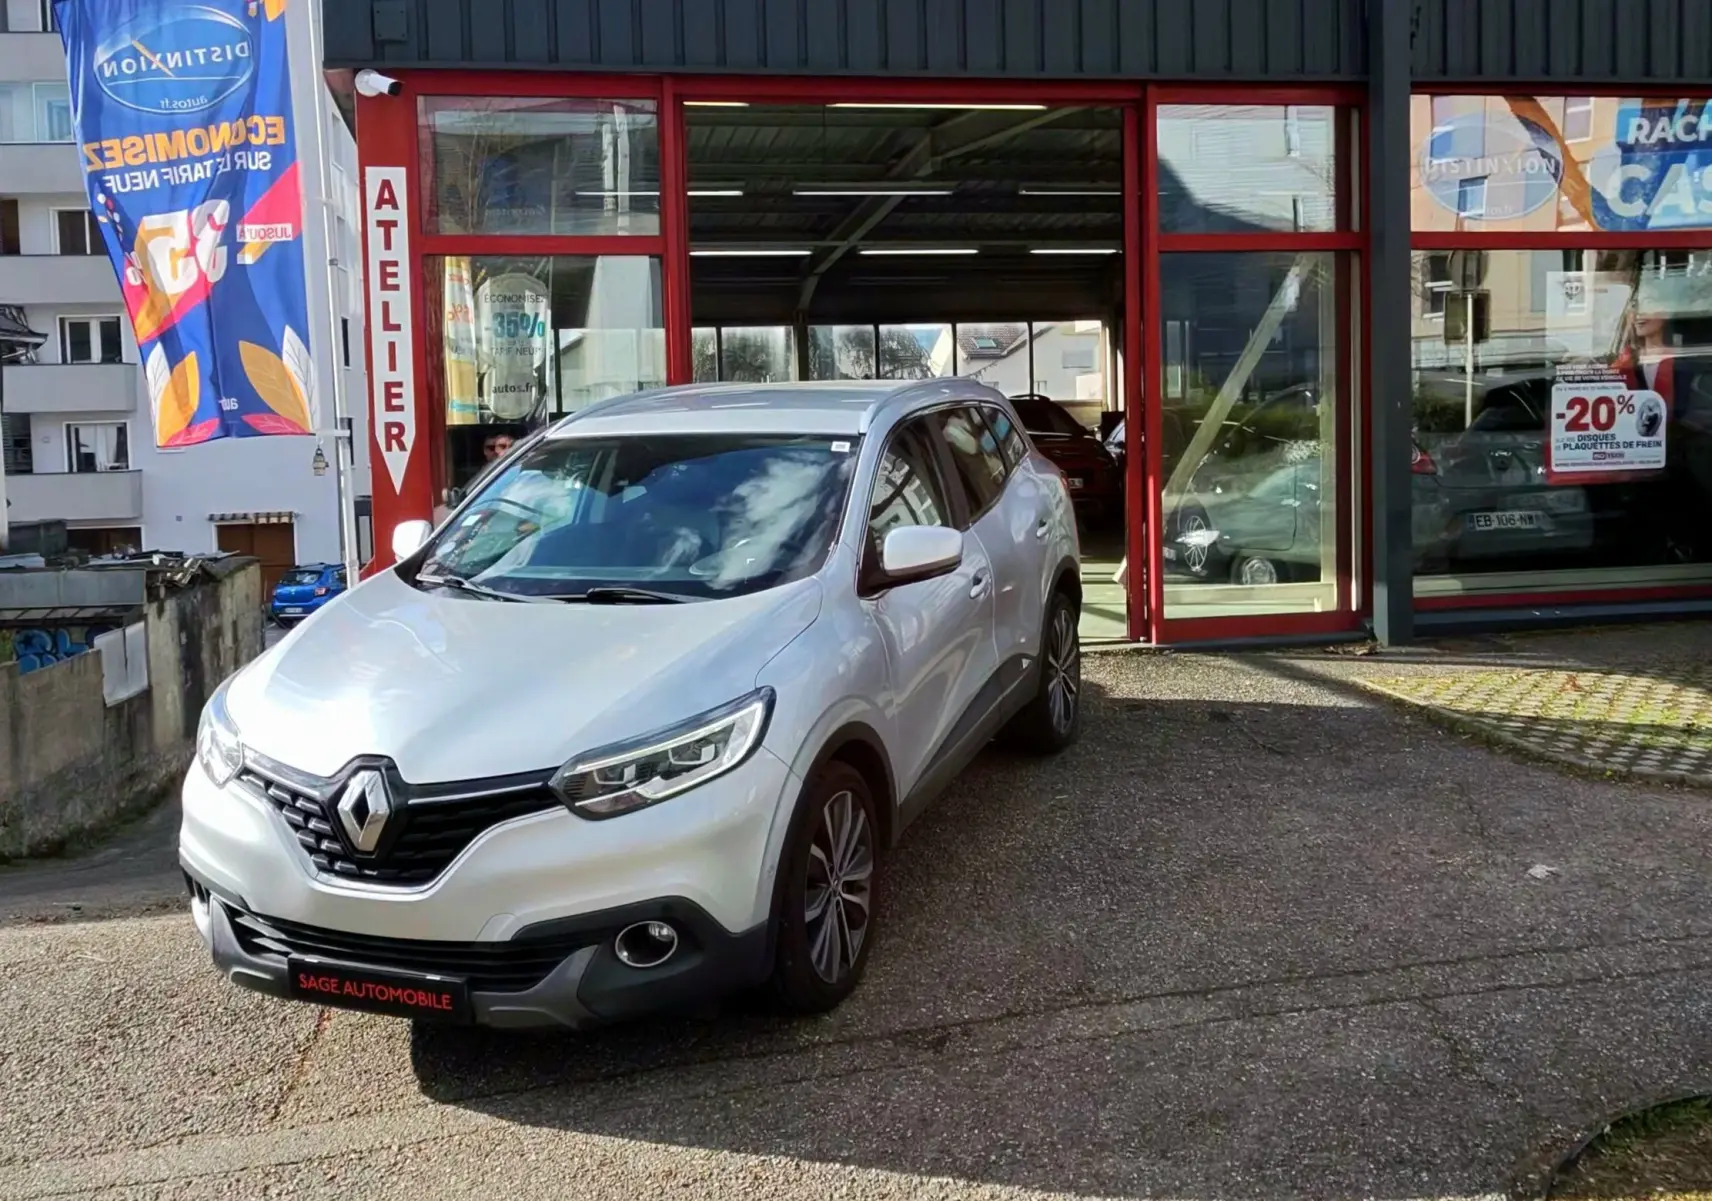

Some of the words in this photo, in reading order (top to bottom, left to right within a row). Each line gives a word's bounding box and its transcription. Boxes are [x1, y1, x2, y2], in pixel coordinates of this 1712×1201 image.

[374, 179, 408, 453] ATELIER
[1562, 441, 1621, 451] PLAQUETTES
[1622, 441, 1635, 449] DE
[1636, 440, 1662, 448] FREIN
[1576, 433, 1616, 442] DISQUES
[299, 973, 340, 994] SAGE
[343, 980, 453, 1010] AUTOMOBILE
